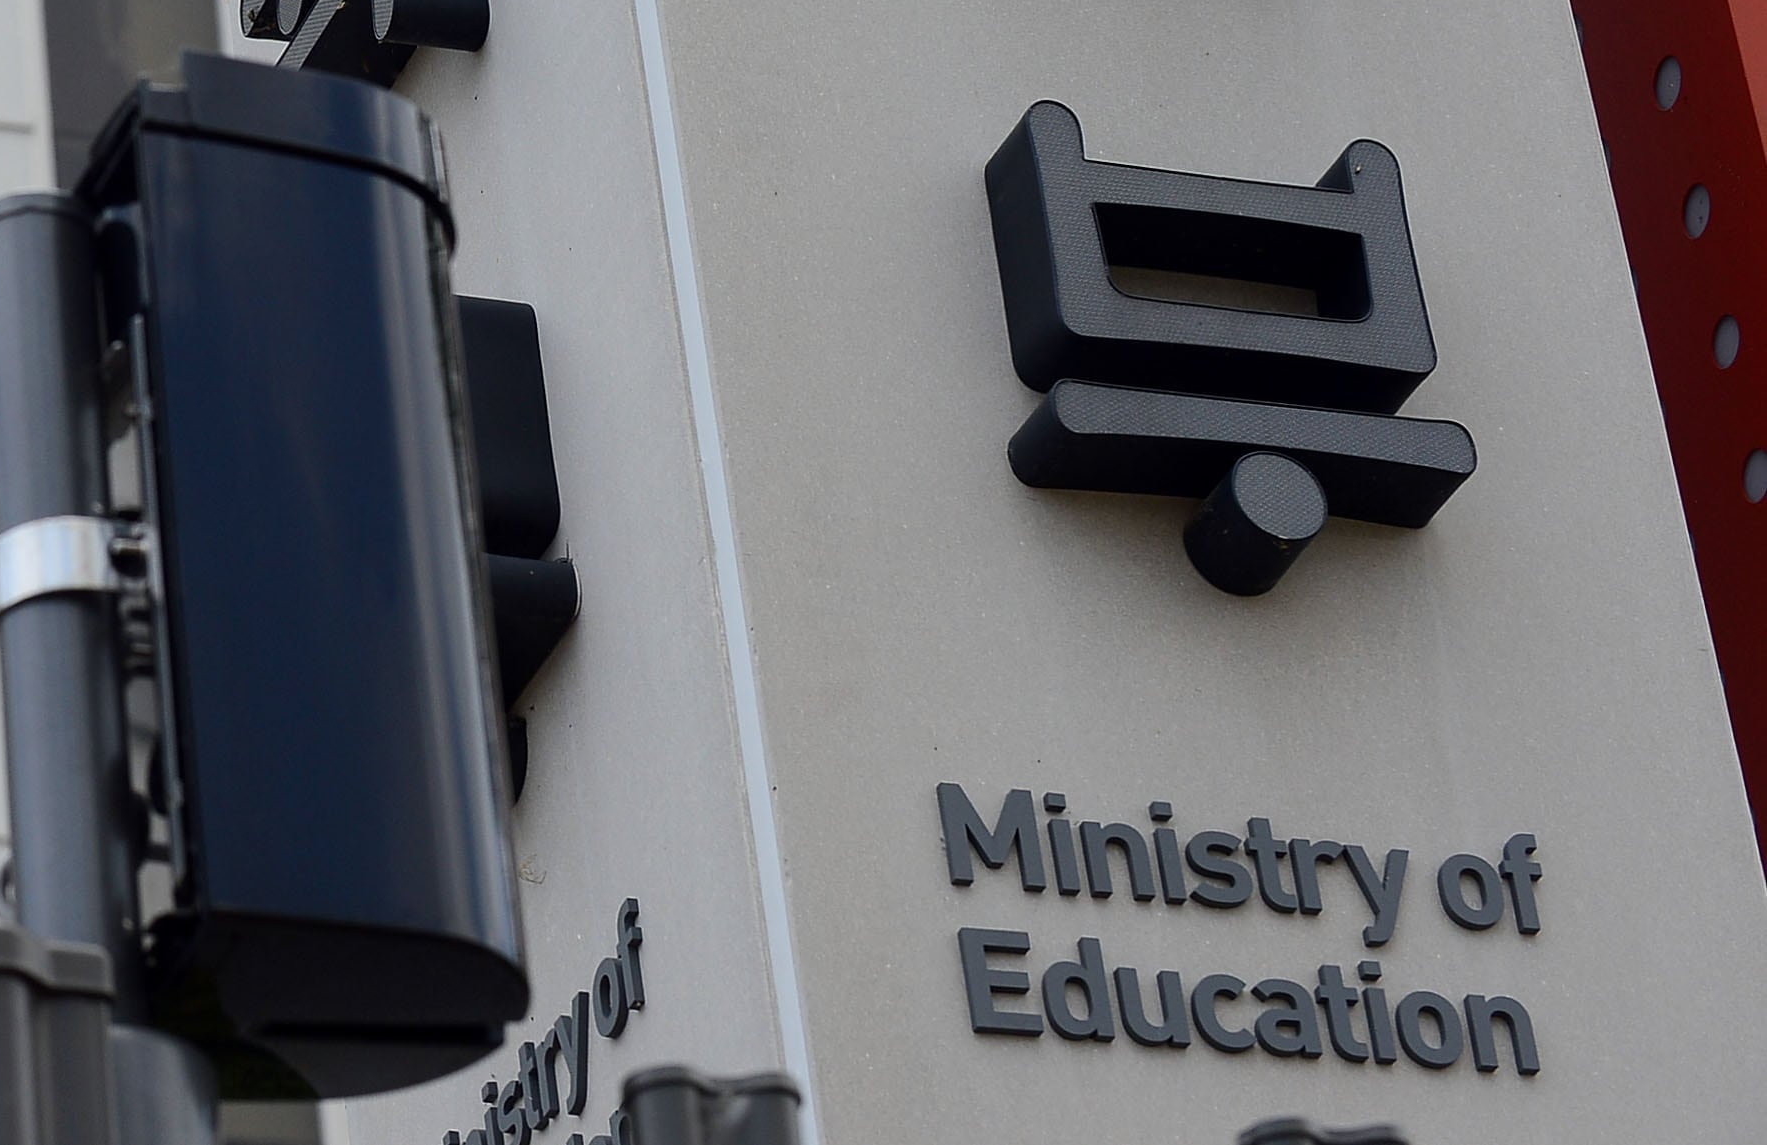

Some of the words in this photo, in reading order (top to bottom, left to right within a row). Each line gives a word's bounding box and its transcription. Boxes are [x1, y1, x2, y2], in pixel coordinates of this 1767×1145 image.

[936, 781, 1410, 947] Ministry
[1436, 832, 1543, 934] of
[593, 897, 646, 1038] of
[957, 926, 1541, 1076] Education
